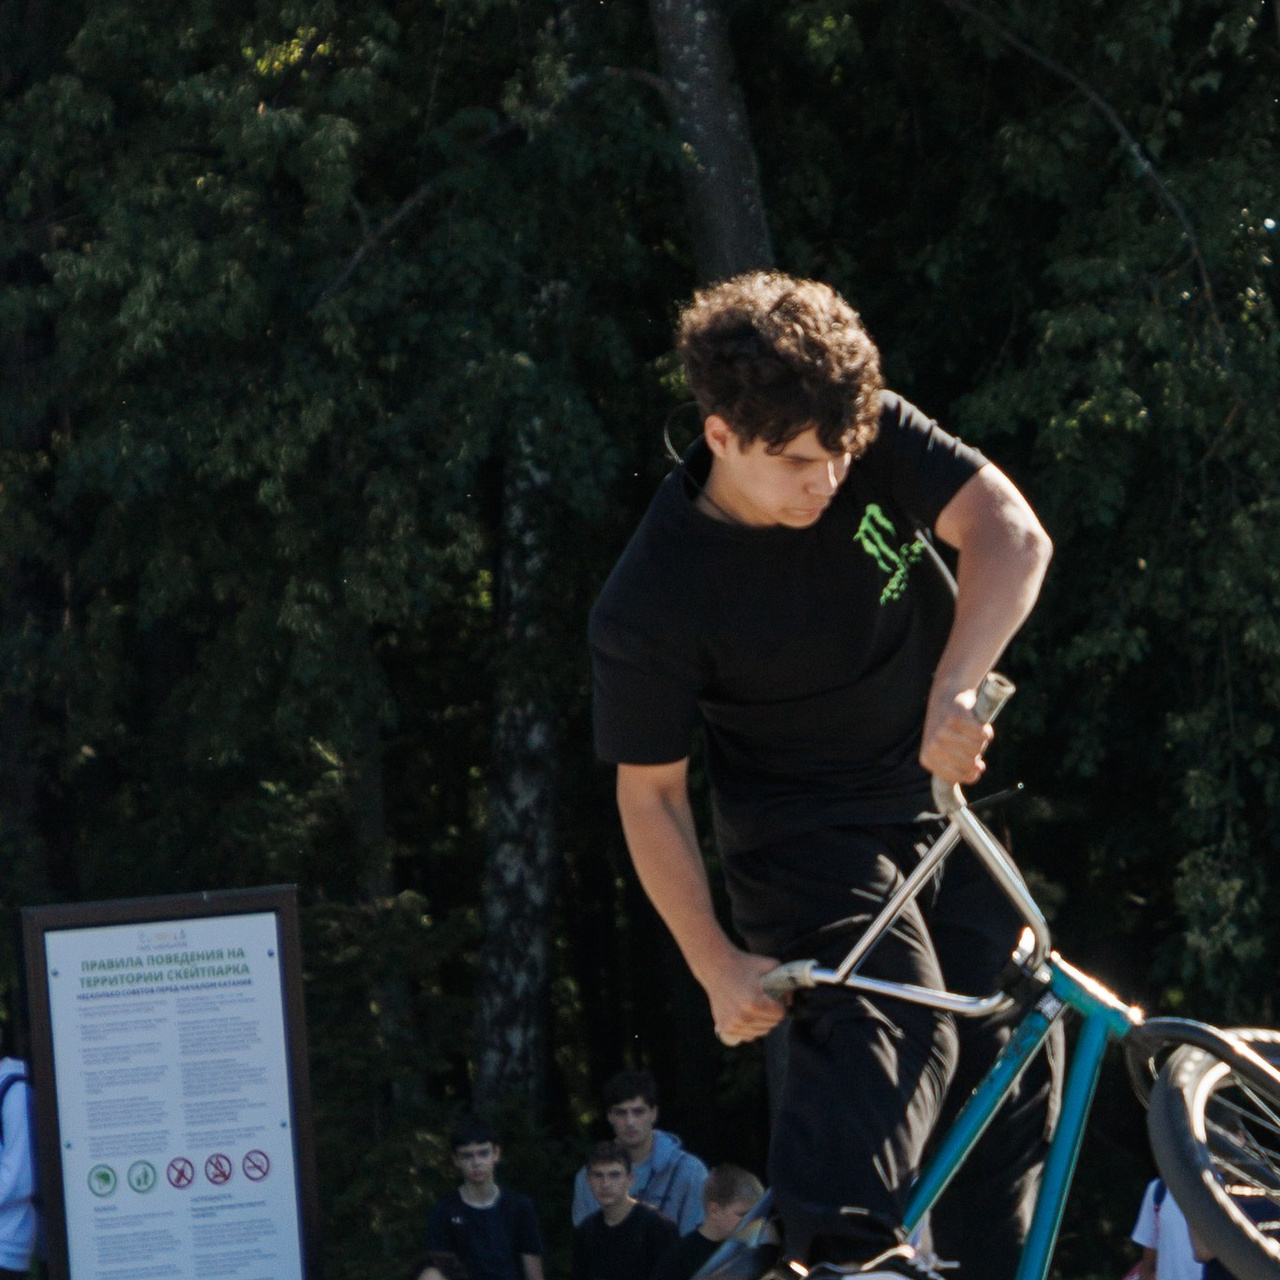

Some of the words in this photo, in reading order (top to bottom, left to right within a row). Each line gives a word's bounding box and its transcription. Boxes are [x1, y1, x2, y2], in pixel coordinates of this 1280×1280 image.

[81, 956, 143, 972] ПРАВИЛА
[146, 949, 224, 966] ПОВЕДЕНИЯ
[227, 947, 245, 959] НА
[79, 971, 164, 989] ТЕРРИТОРИИ
[167, 963, 250, 981] СКЕЙТПАРКА
